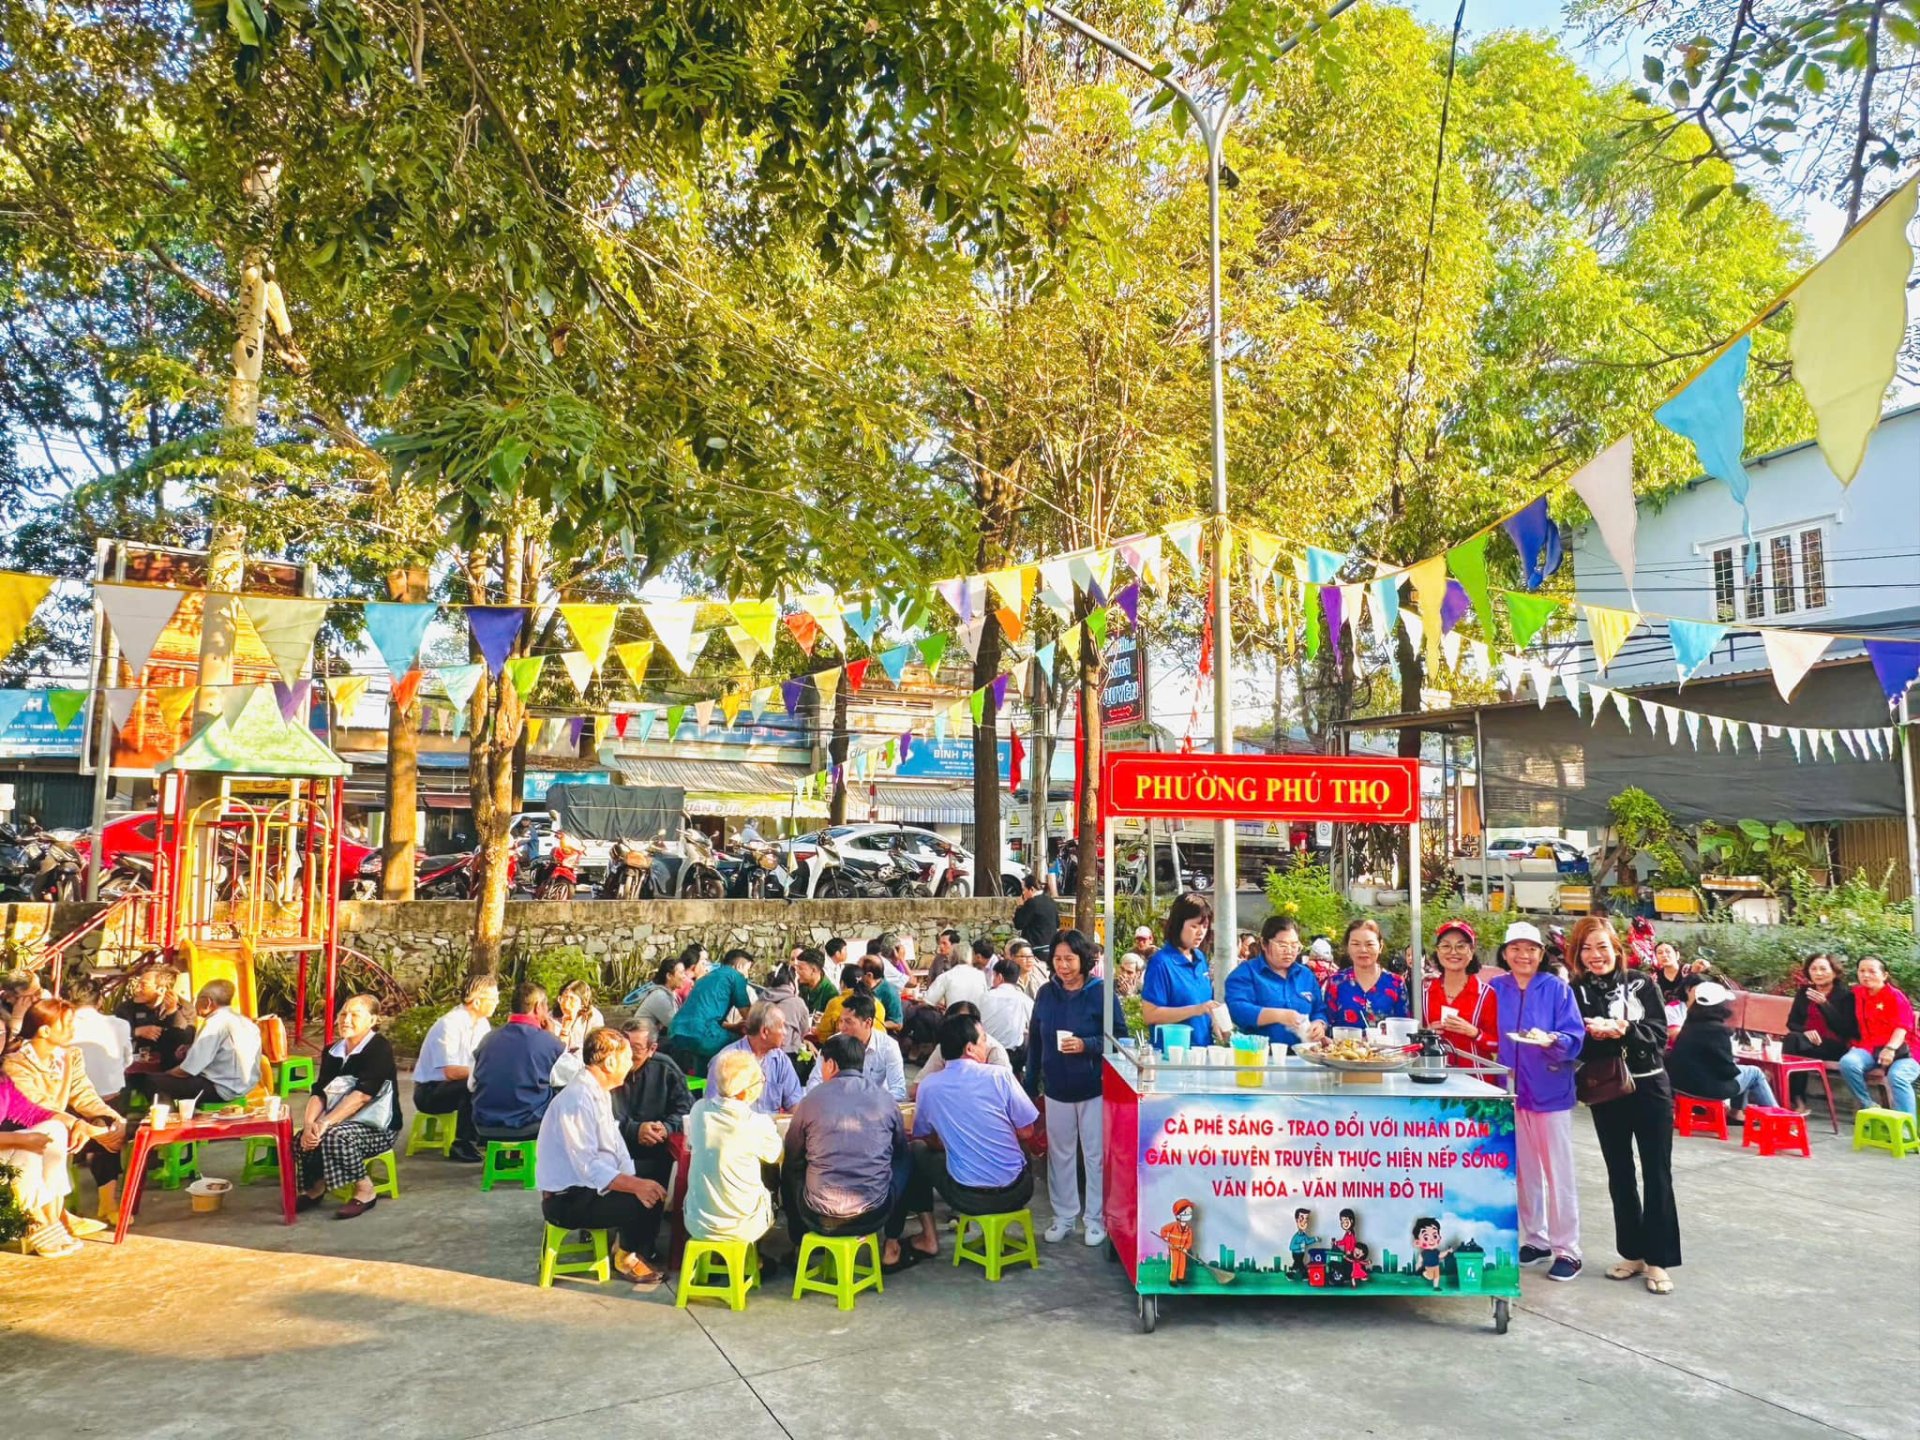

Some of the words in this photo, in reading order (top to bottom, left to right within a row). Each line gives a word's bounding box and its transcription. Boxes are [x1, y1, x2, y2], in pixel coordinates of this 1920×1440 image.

[1108, 657, 1132, 679] KIM
[1135, 769, 1257, 802] PHƯỜNG
[1266, 771, 1322, 804] PHÚ
[1329, 779, 1390, 811] THỌ
[1164, 1114, 1189, 1135] CÀ
[1194, 1115, 1224, 1136] PHÊ
[1228, 1115, 1274, 1136] SÁNG
[1287, 1119, 1329, 1137] TRAO
[1335, 1111, 1364, 1137] ĐỔI
[1370, 1116, 1398, 1137] VỚI
[1404, 1117, 1450, 1138] NHÂN
[1455, 1118, 1491, 1139] DÂN
[1144, 1141, 1182, 1165] GẮN
[1188, 1145, 1216, 1166] VỚI
[1221, 1145, 1270, 1167] TUYÊN
[1275, 1142, 1333, 1167] TRUYỀN
[1338, 1149, 1381, 1172] THỰC
[1387, 1147, 1422, 1173] HIỆN
[1428, 1145, 1458, 1168] NẾP
[1462, 1145, 1510, 1169] SỐNG
[1213, 1176, 1246, 1197] VĂN
[1252, 1176, 1288, 1198] HÓA
[1302, 1177, 1337, 1198] VĂN
[1342, 1181, 1385, 1199] MINH
[1389, 1177, 1415, 1199] ĐÔ
[1419, 1182, 1443, 1203] THỊ
